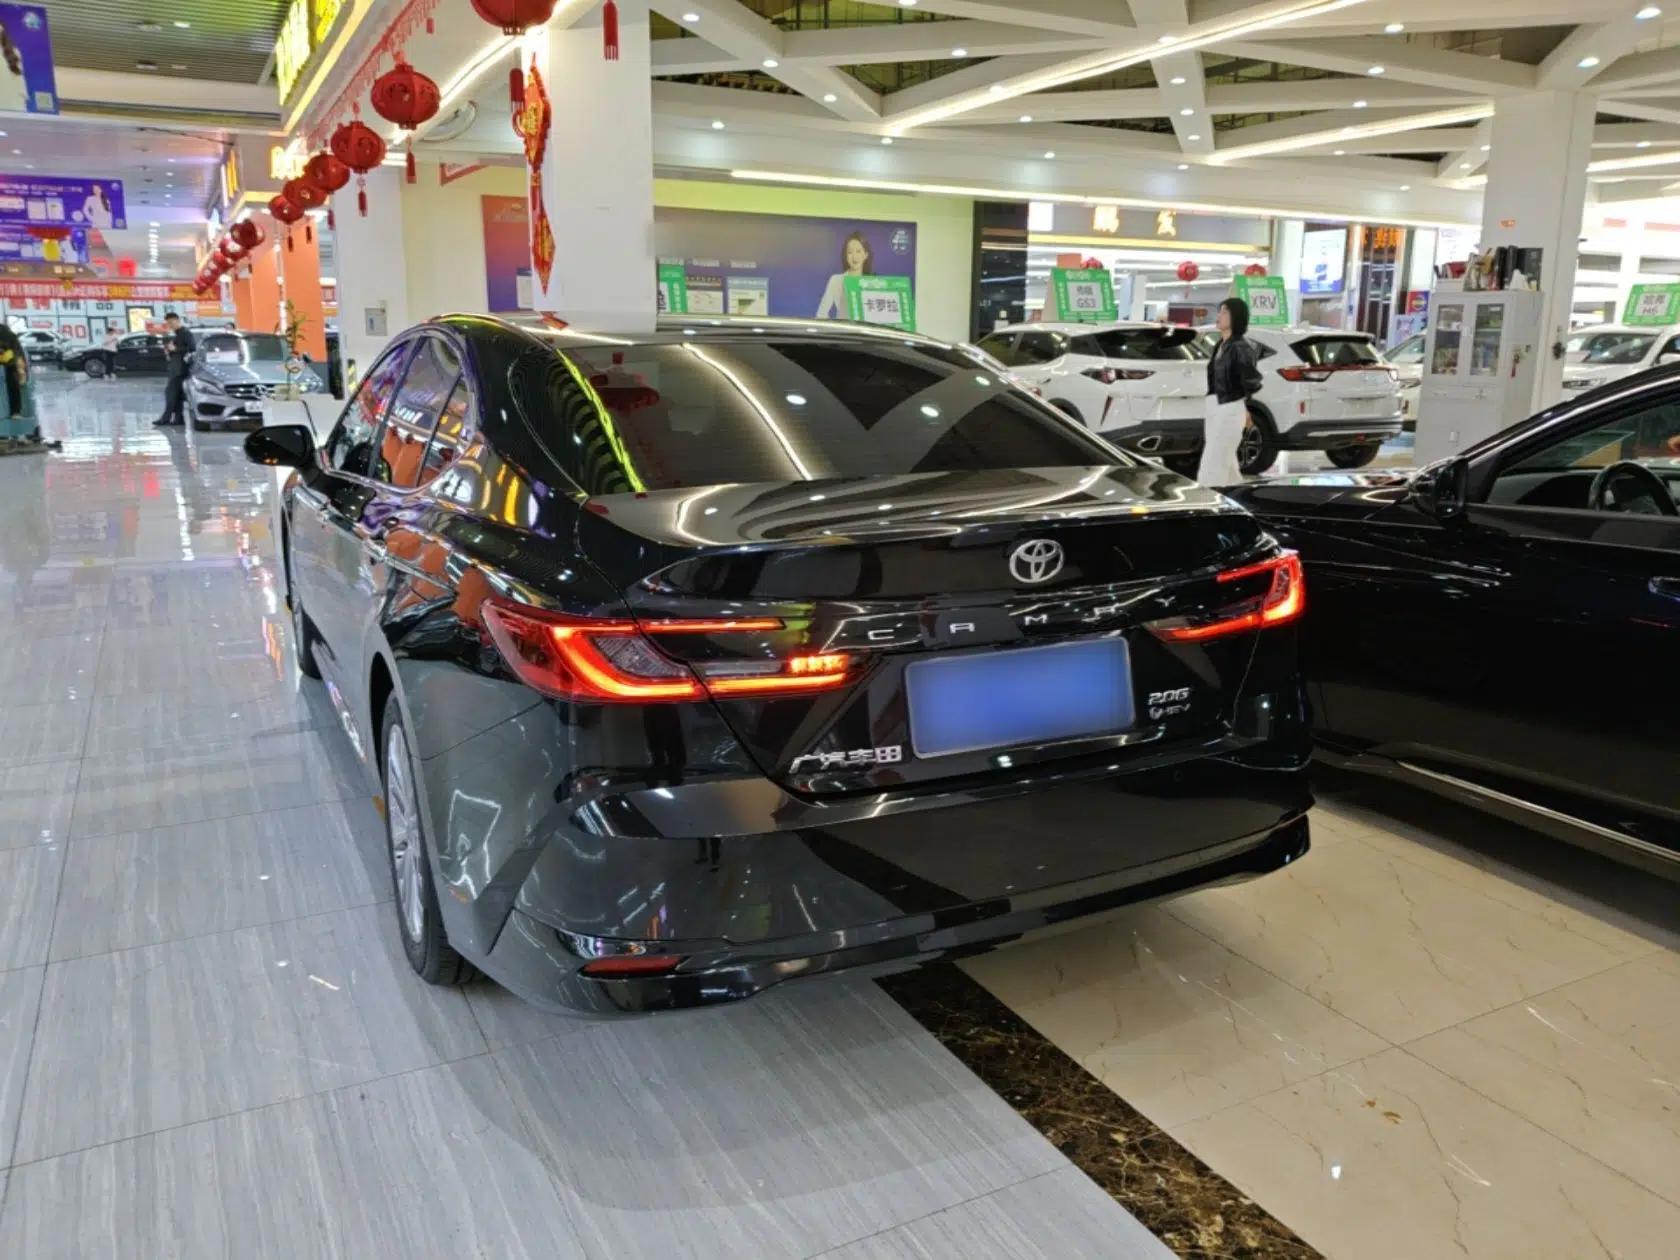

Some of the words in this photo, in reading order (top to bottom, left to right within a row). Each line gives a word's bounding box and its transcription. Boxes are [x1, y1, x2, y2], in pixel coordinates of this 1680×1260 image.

[863, 299, 898, 313] 卡罗拉
[1252, 295, 1277, 309] XRV
[867, 596, 1175, 640] CAMRY
[789, 745, 902, 774] 广汽丰田
